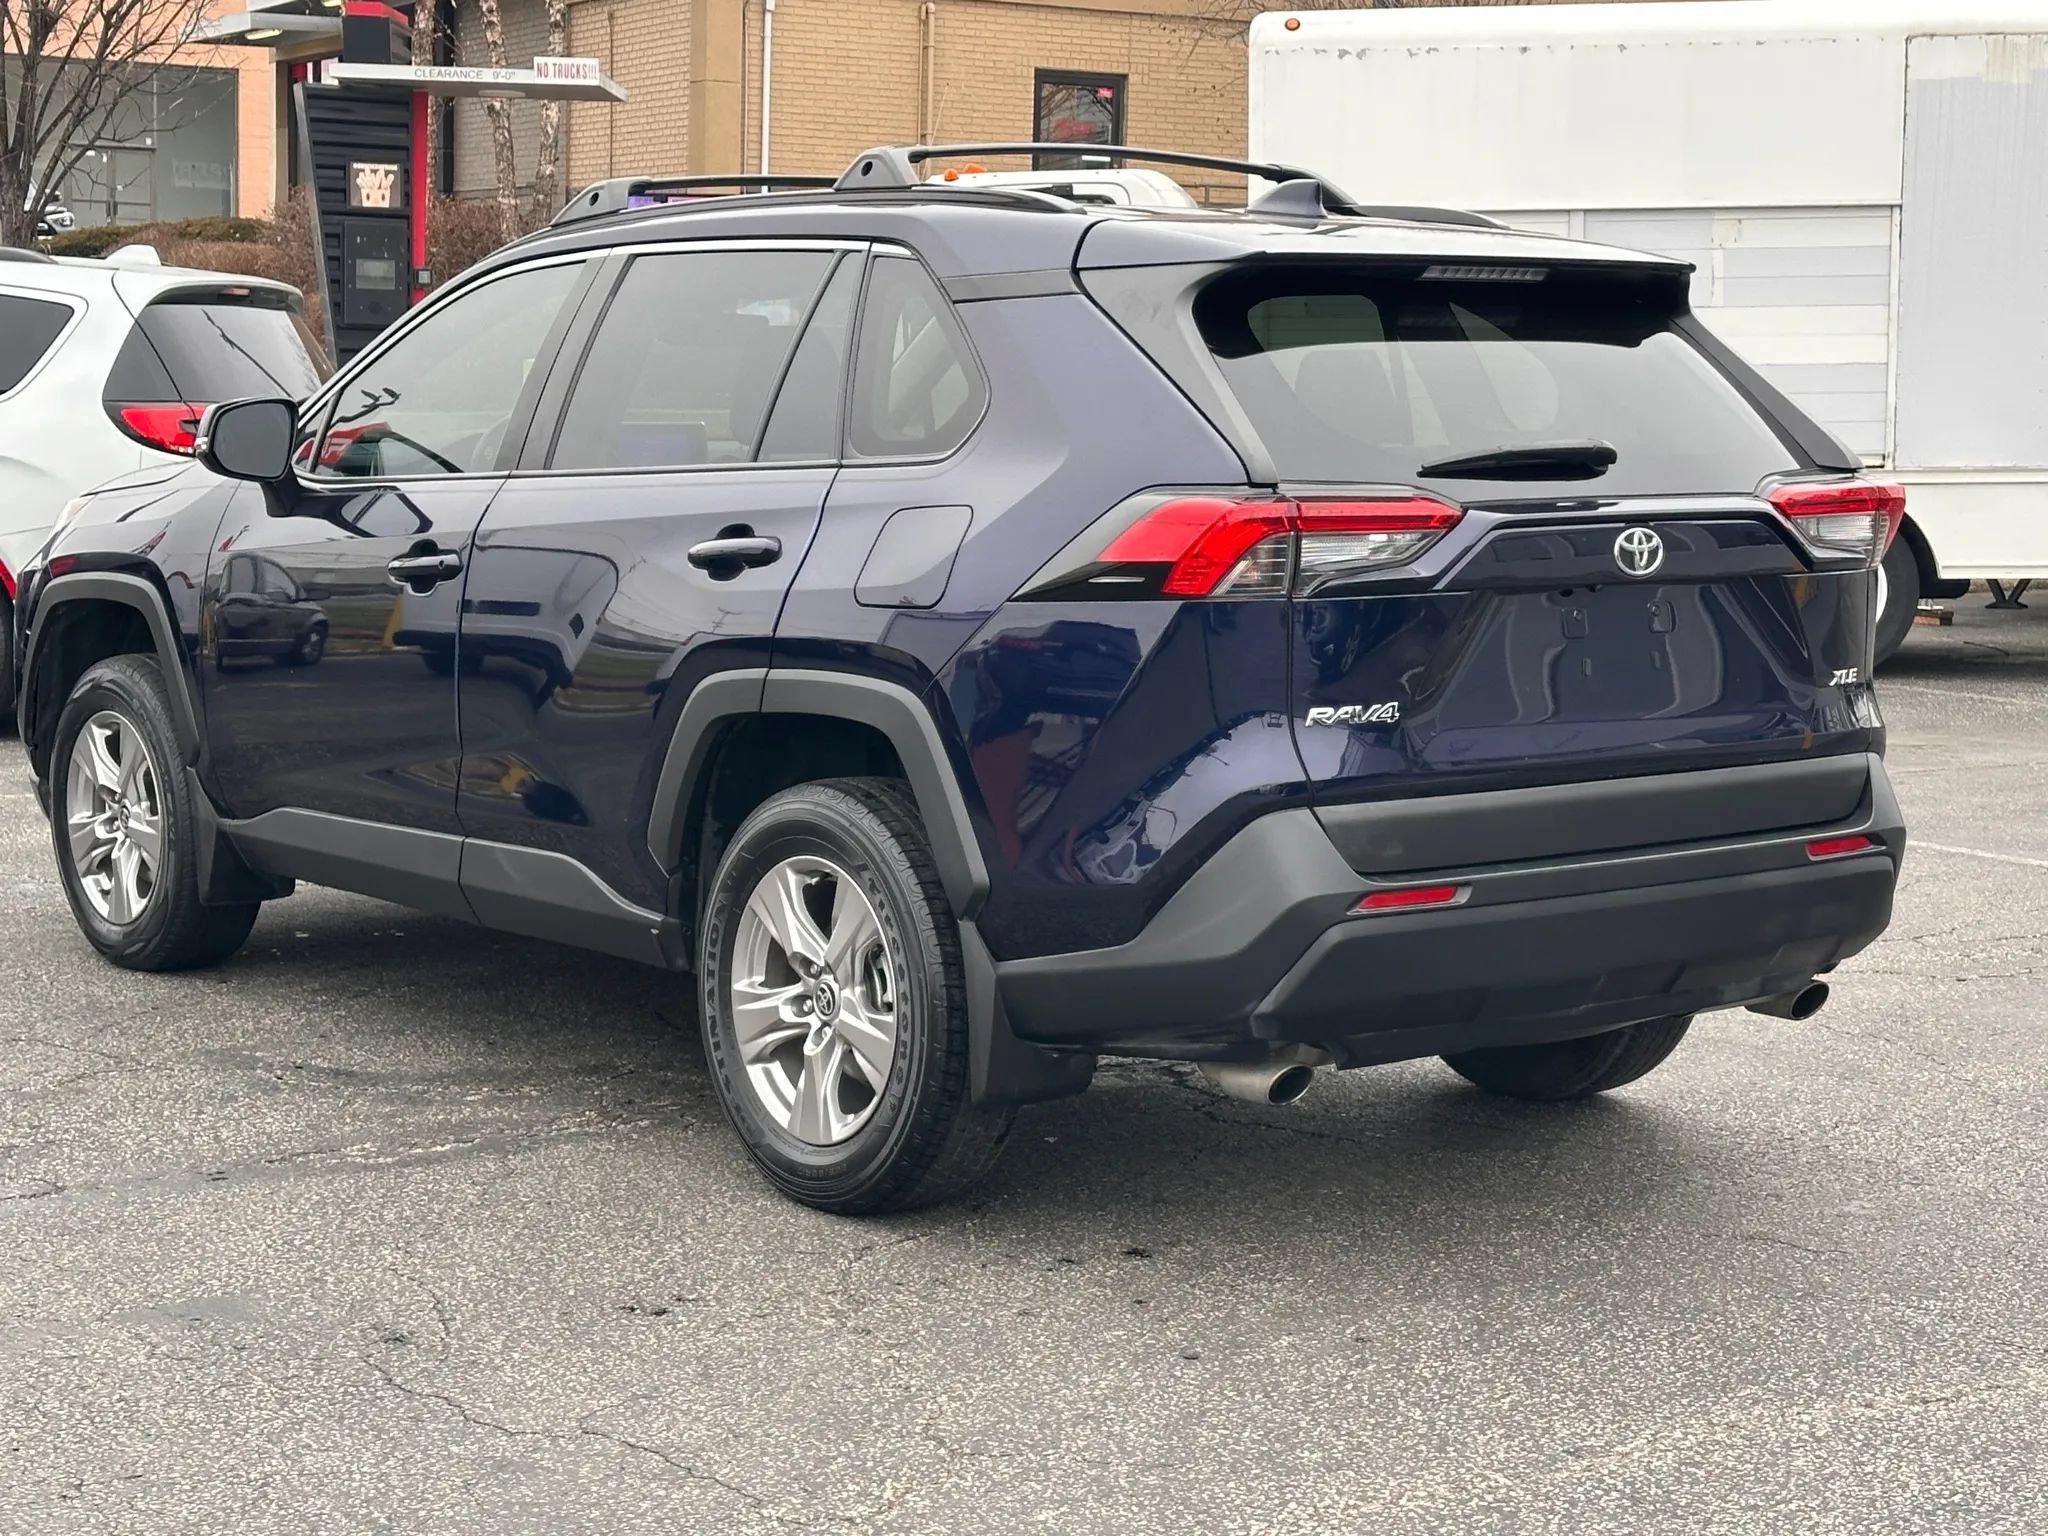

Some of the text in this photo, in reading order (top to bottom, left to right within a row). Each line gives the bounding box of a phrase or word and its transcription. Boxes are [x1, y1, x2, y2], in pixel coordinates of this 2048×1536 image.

[414, 68, 483, 80] CLEARANCE
[536, 62, 597, 80] NO TRUCKS!!!
[1828, 667, 1858, 686] XLE
[1304, 701, 1400, 727] RAV4
